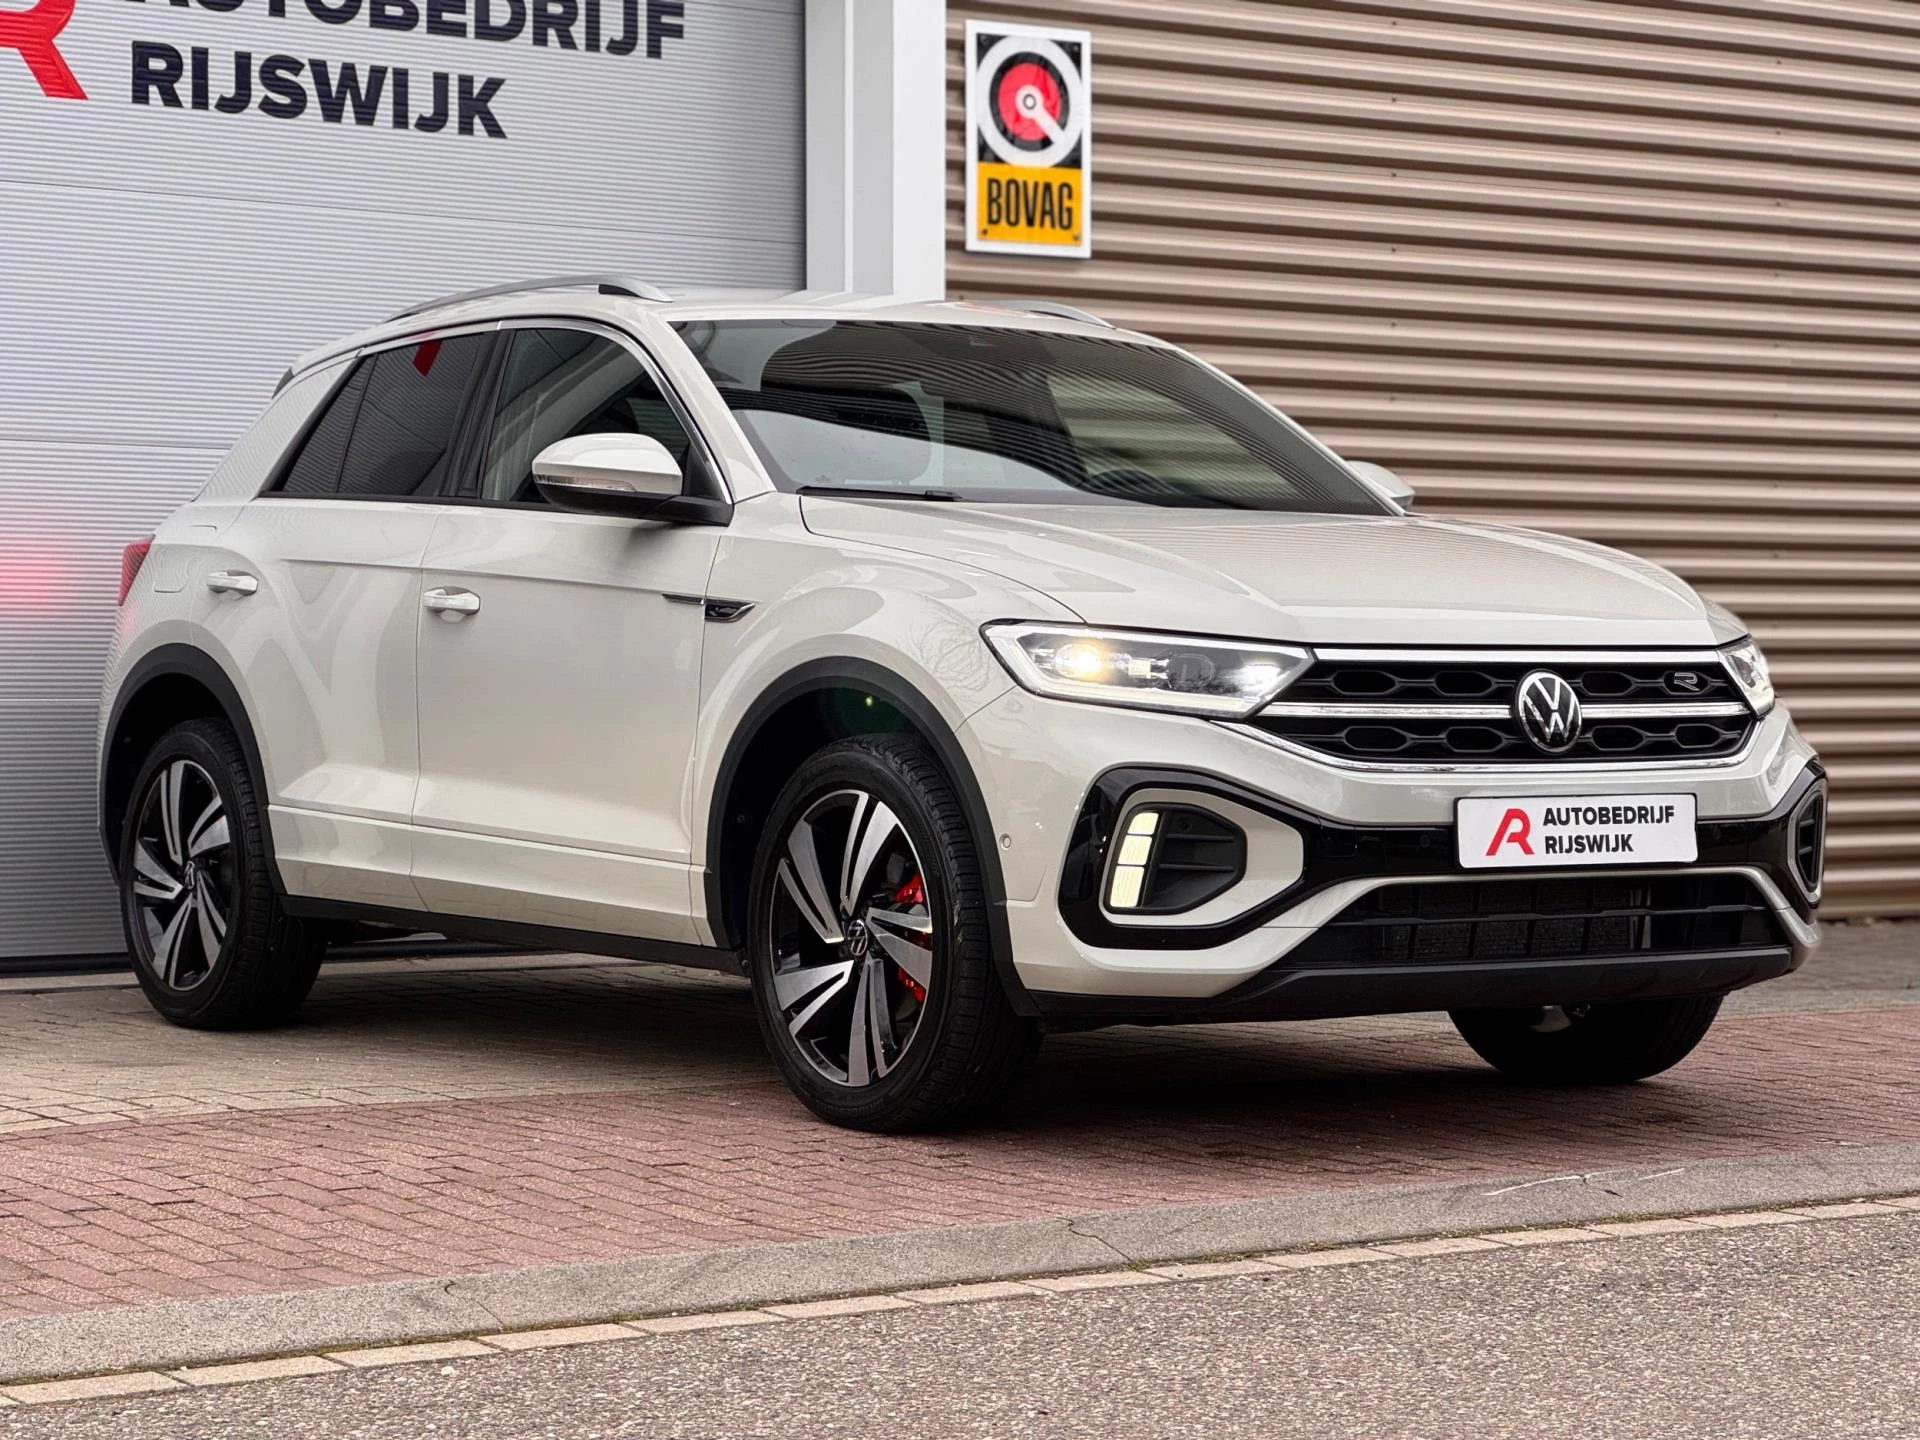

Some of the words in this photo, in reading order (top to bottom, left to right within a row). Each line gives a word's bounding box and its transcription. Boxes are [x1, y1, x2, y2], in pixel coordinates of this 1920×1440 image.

[124, 0, 685, 60] BEDRIJF
[131, 40, 508, 140] RIJSWIJK
[986, 177, 1074, 231] BOVAG
[1542, 805, 1675, 826] AUTOBEDRIJF
[1544, 833, 1634, 854] RIJSWIJK
